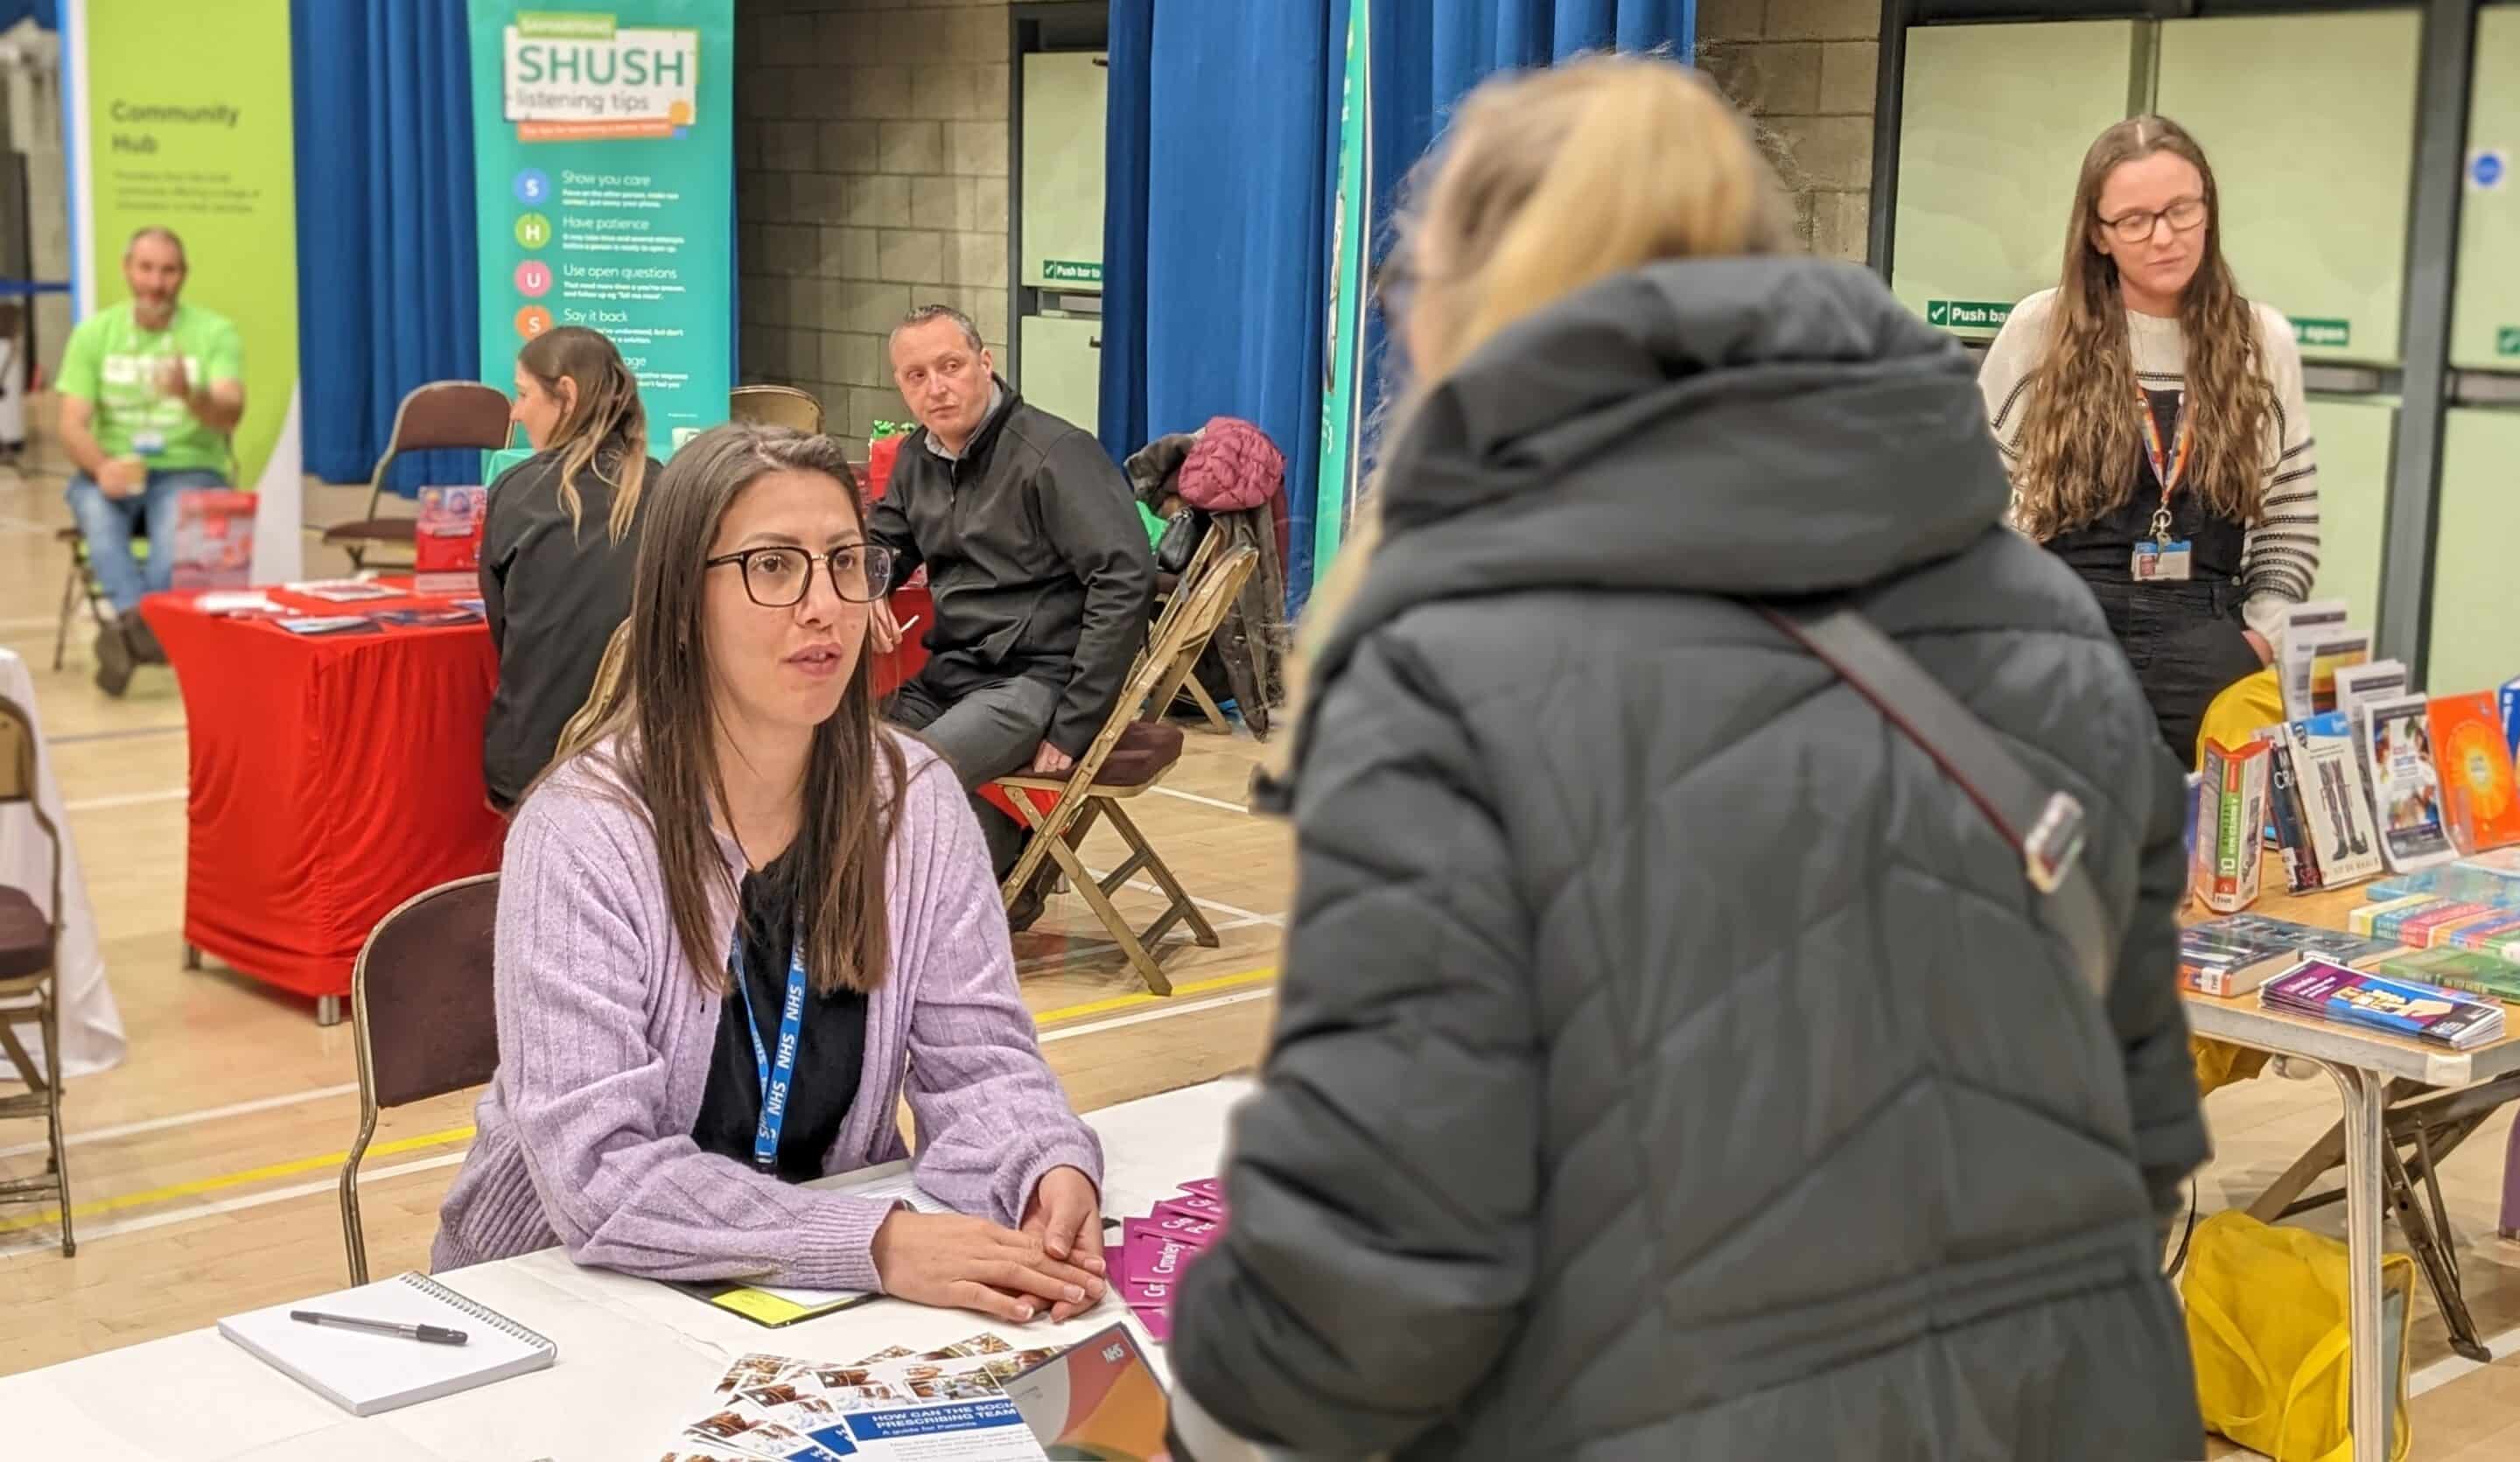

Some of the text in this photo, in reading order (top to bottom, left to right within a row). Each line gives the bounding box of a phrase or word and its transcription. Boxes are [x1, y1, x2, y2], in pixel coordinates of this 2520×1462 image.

[517, 45, 684, 87] SHUSH
[517, 89, 649, 114] listening tips
[111, 98, 240, 129] Community
[112, 133, 158, 155] Hub
[562, 170, 651, 187] Show you care
[526, 179, 539, 198] S
[563, 216, 649, 231] Have patience
[525, 225, 540, 241] H
[527, 272, 541, 288] U
[564, 263, 677, 281] Use open questions
[1056, 265, 1101, 278] Push bar to
[564, 308, 628, 323] Say it back
[1952, 307, 1986, 321] Push
[528, 318, 541, 332] S
[787, 984, 802, 1021] NHS
[777, 1032, 794, 1069] NHS
[767, 1081, 786, 1116] NHS
[1102, 1343, 1125, 1363] NHS
[872, 1412, 906, 1423] HOW
[911, 1409, 941, 1419] CAN
[944, 1405, 973, 1416] THE
[875, 1407, 1017, 1429] PRESCRIBING TEAM
[892, 1428, 917, 1437] guide
[937, 1421, 977, 1431] Patients
